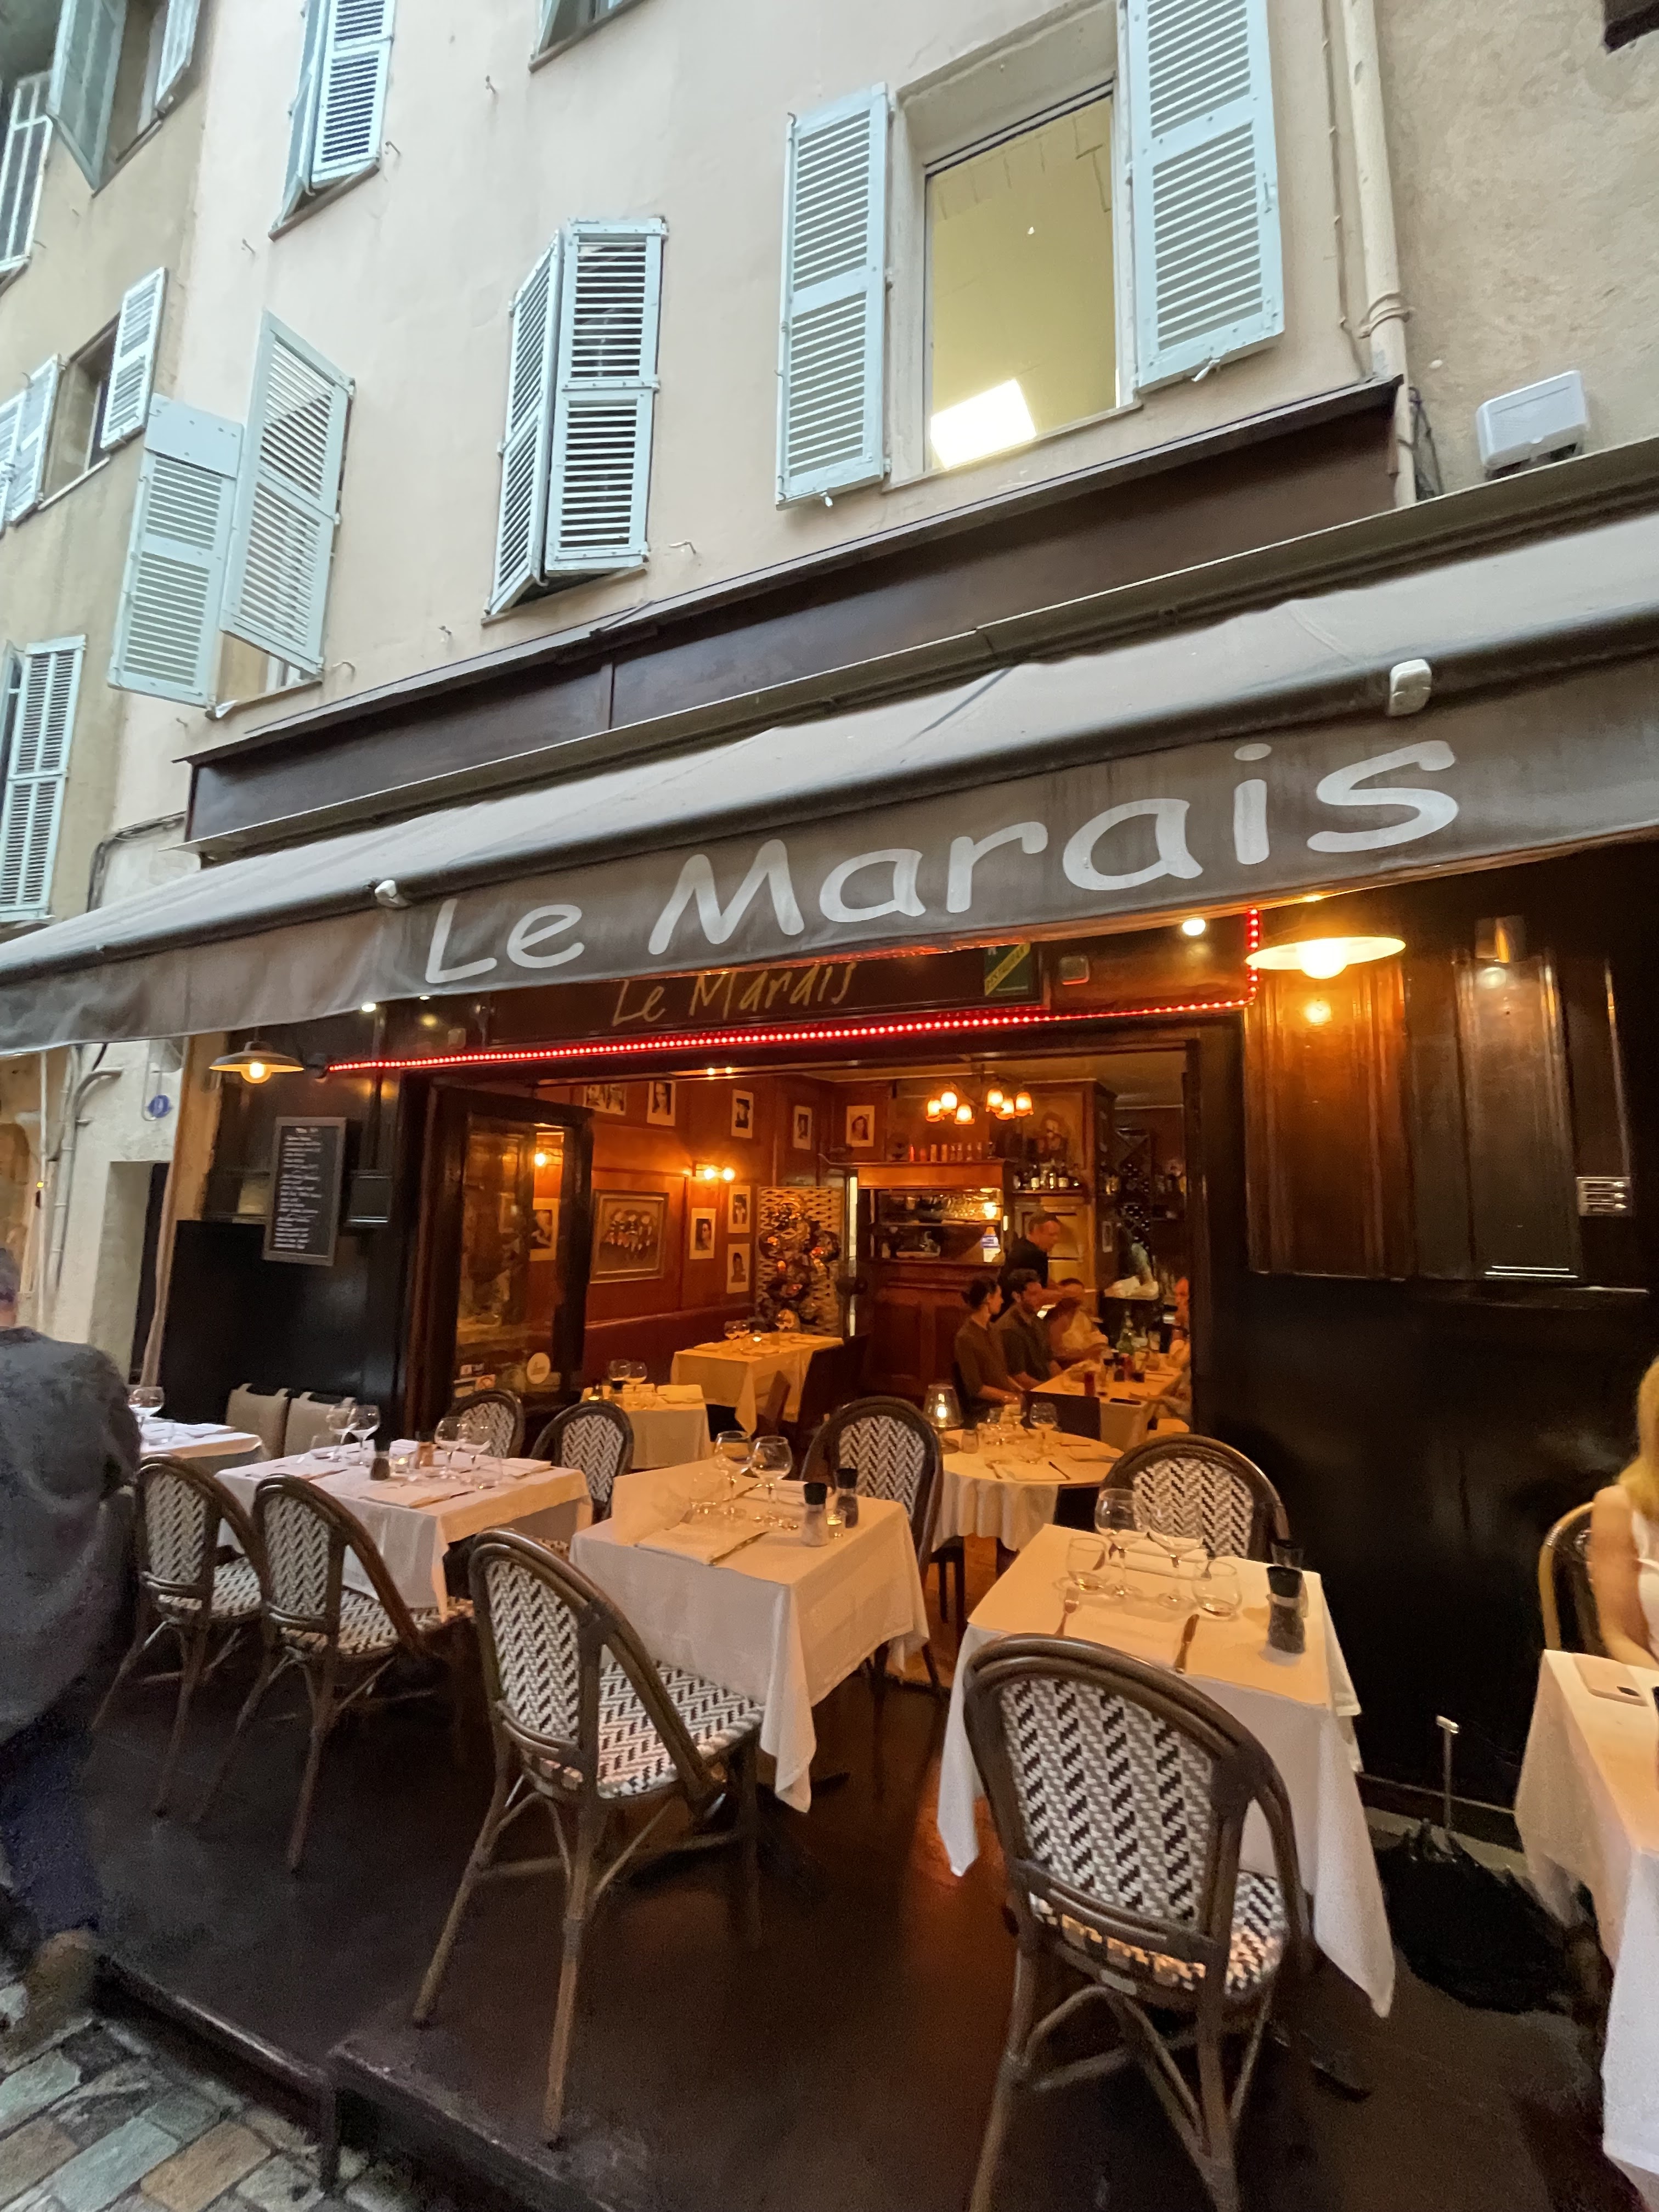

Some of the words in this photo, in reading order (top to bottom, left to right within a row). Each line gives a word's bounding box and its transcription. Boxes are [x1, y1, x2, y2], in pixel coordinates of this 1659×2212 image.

[425, 898, 585, 984] Le
[648, 740, 1459, 955] Marais
[611, 979, 666, 1027] Le
[688, 961, 857, 1020] Marais
